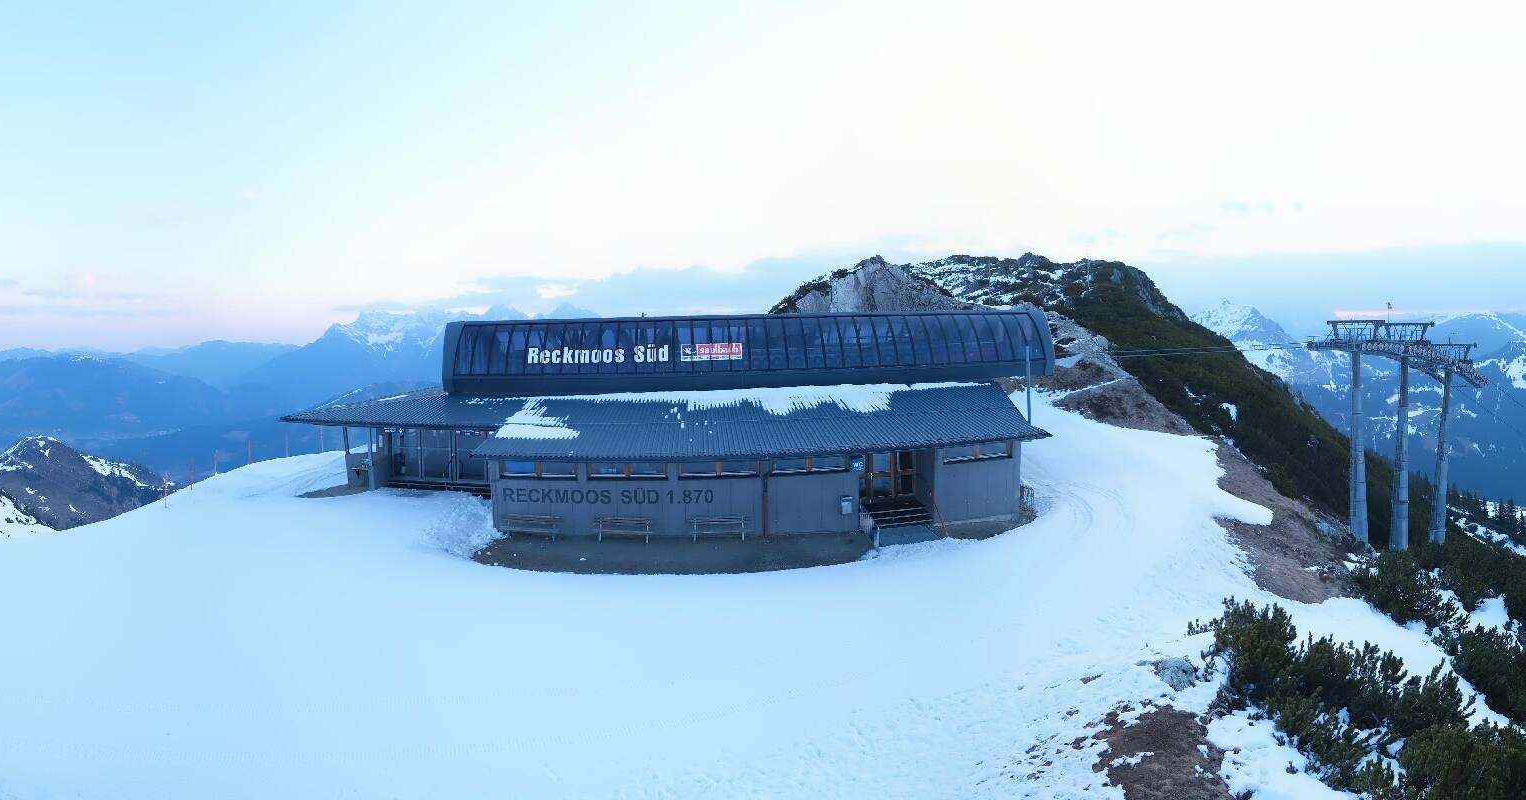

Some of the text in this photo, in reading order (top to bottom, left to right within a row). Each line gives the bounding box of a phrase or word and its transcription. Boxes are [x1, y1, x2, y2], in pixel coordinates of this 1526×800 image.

[528, 343, 669, 364] Reckmoos Süd
[502, 487, 714, 504] RECKMOOS SÜD 1.870
